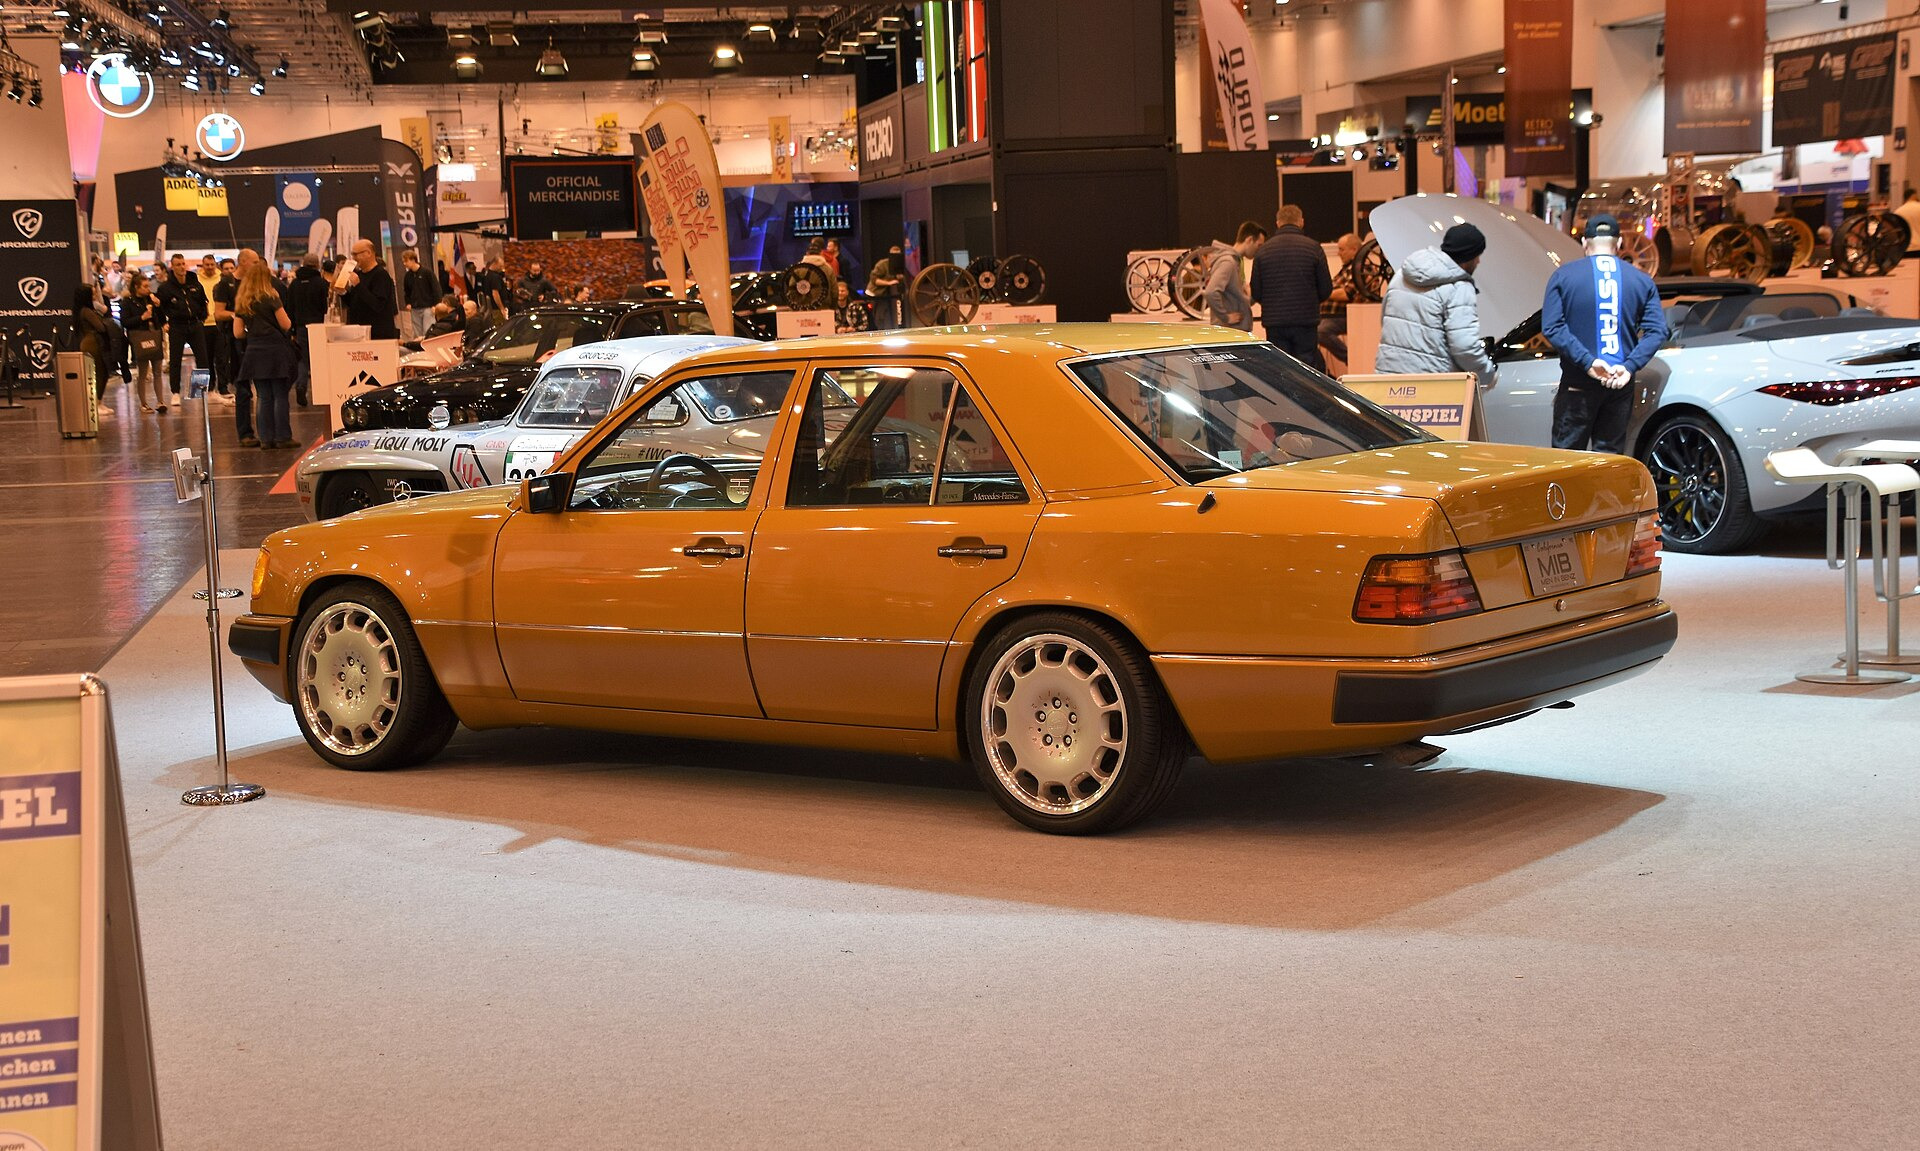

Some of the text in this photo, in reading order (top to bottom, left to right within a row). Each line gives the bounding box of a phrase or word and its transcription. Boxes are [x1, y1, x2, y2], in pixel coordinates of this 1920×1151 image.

[865, 116, 894, 162] RECARO
[166, 179, 196, 190] ADAC
[546, 176, 602, 188] OFFICIAL
[198, 188, 225, 199] ADAC
[528, 190, 620, 203] MERCHANDISE
[1389, 386, 1417, 396] MIB
[349, 439, 370, 449] Cargo
[374, 436, 451, 452] LIQUI MOLY
[1537, 552, 1572, 577] MIB
[0, 1058, 56, 1077] chen
